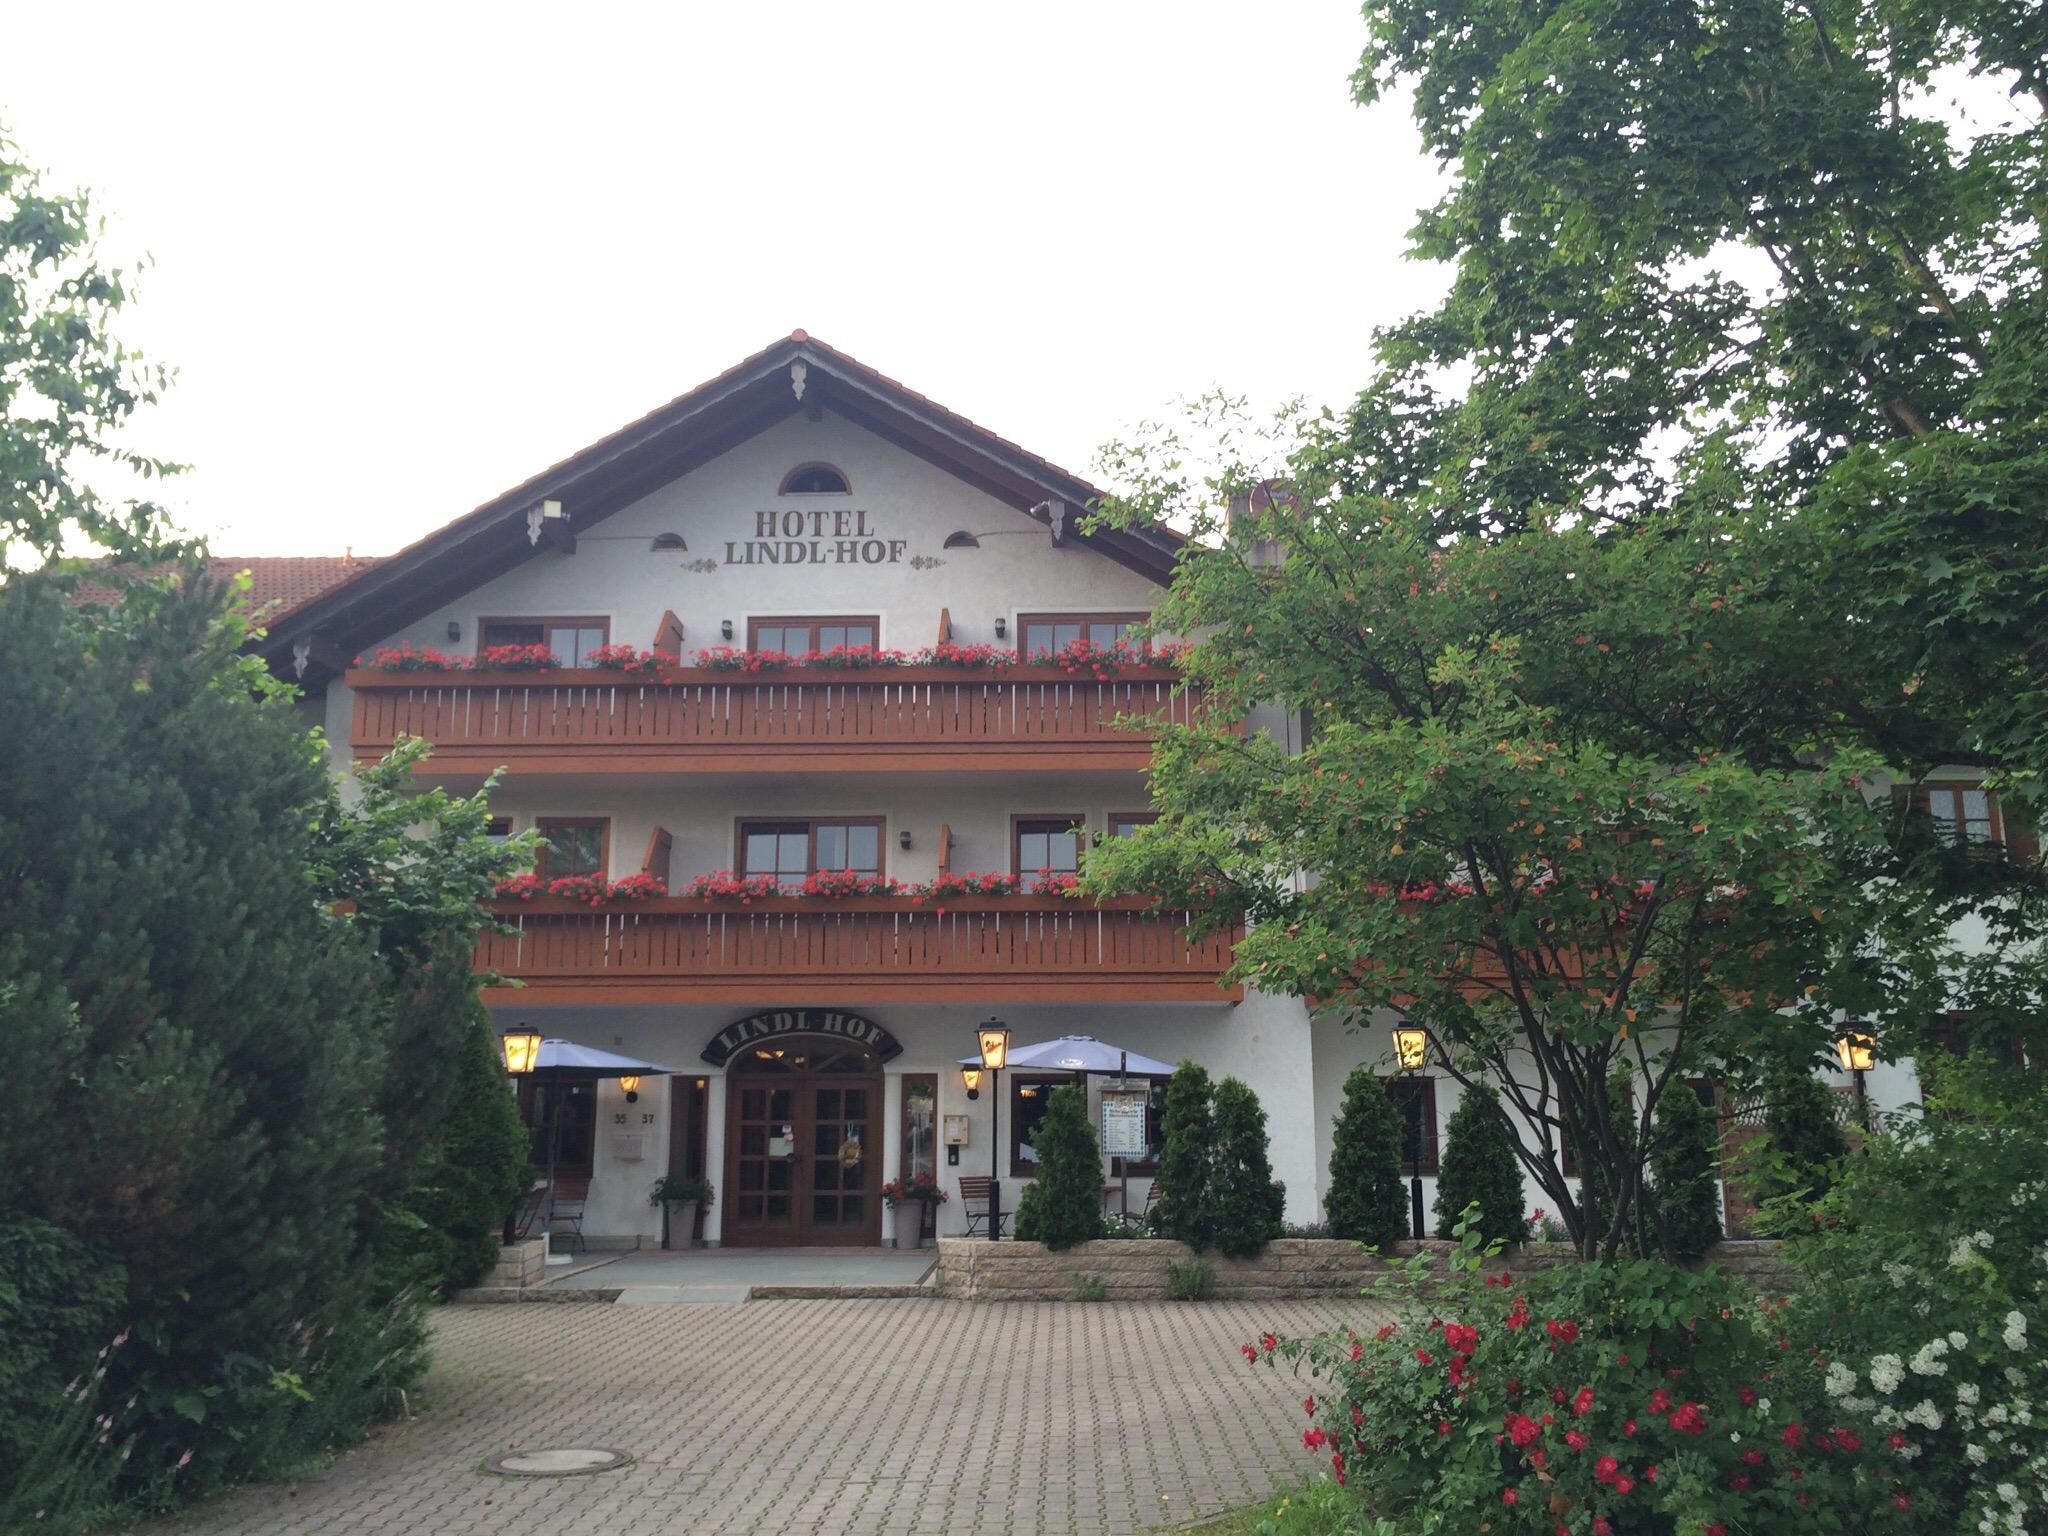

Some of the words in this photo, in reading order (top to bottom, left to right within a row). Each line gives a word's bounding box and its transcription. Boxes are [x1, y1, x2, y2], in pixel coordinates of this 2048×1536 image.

[754, 510, 875, 538] HOTEL
[723, 540, 907, 565] LINDL-HOF
[718, 1011, 811, 1051] LINDL
[823, 1013, 885, 1045] HOF
